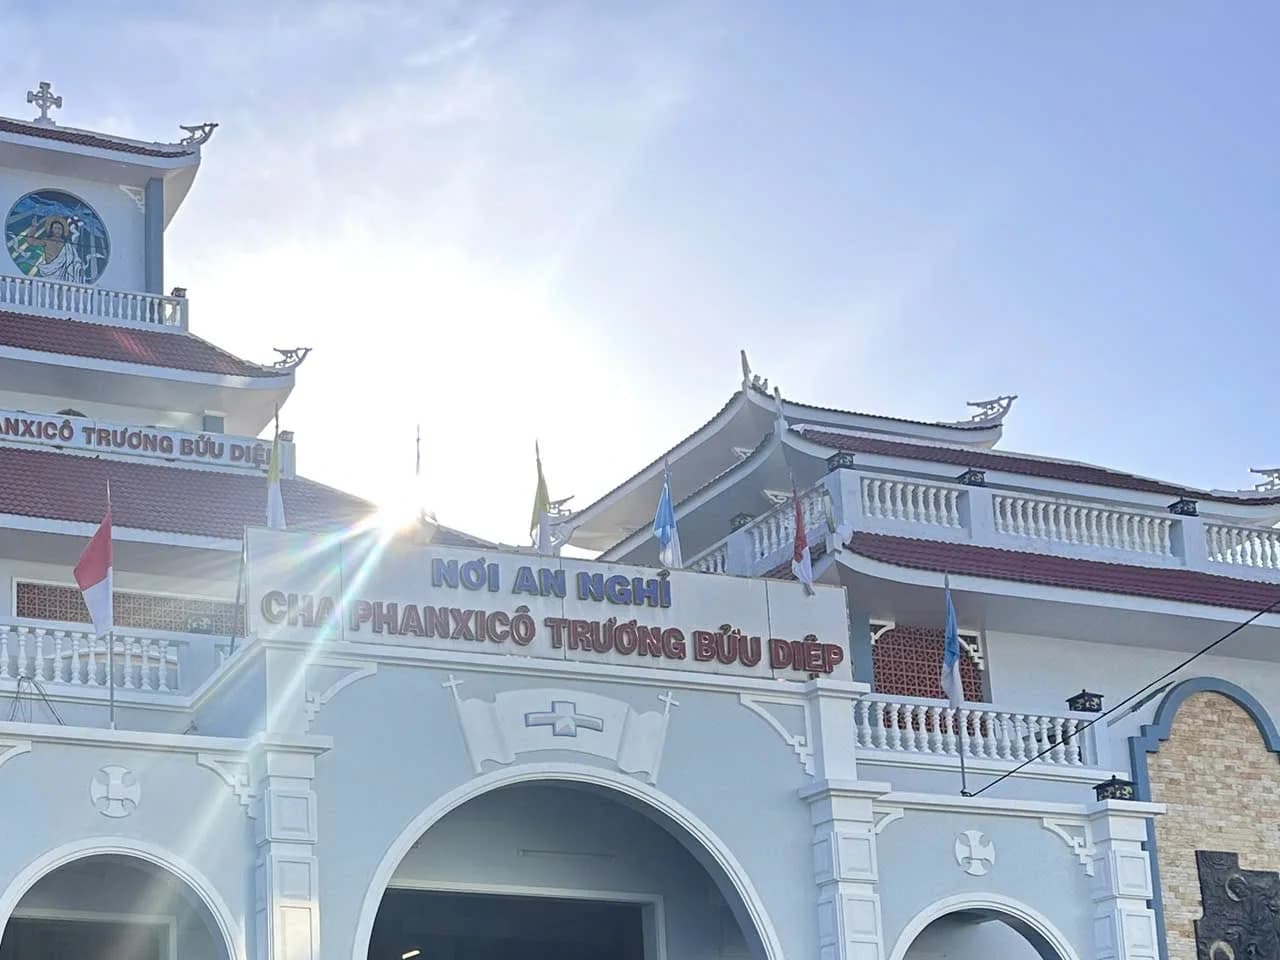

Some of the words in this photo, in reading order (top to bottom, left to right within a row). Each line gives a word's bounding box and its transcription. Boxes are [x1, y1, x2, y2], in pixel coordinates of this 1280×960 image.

[82, 426, 174, 455] TRƯƠNG
[431, 556, 500, 593] NƠI
[512, 566, 567, 599] AN
[576, 569, 672, 608] NGHỈ
[260, 590, 338, 629] CHA
[349, 599, 536, 646] PHANXICÔ
[544, 616, 687, 660] TRƯƠNG
[693, 623, 762, 667] BỬU
[768, 634, 844, 680] DIỆP
